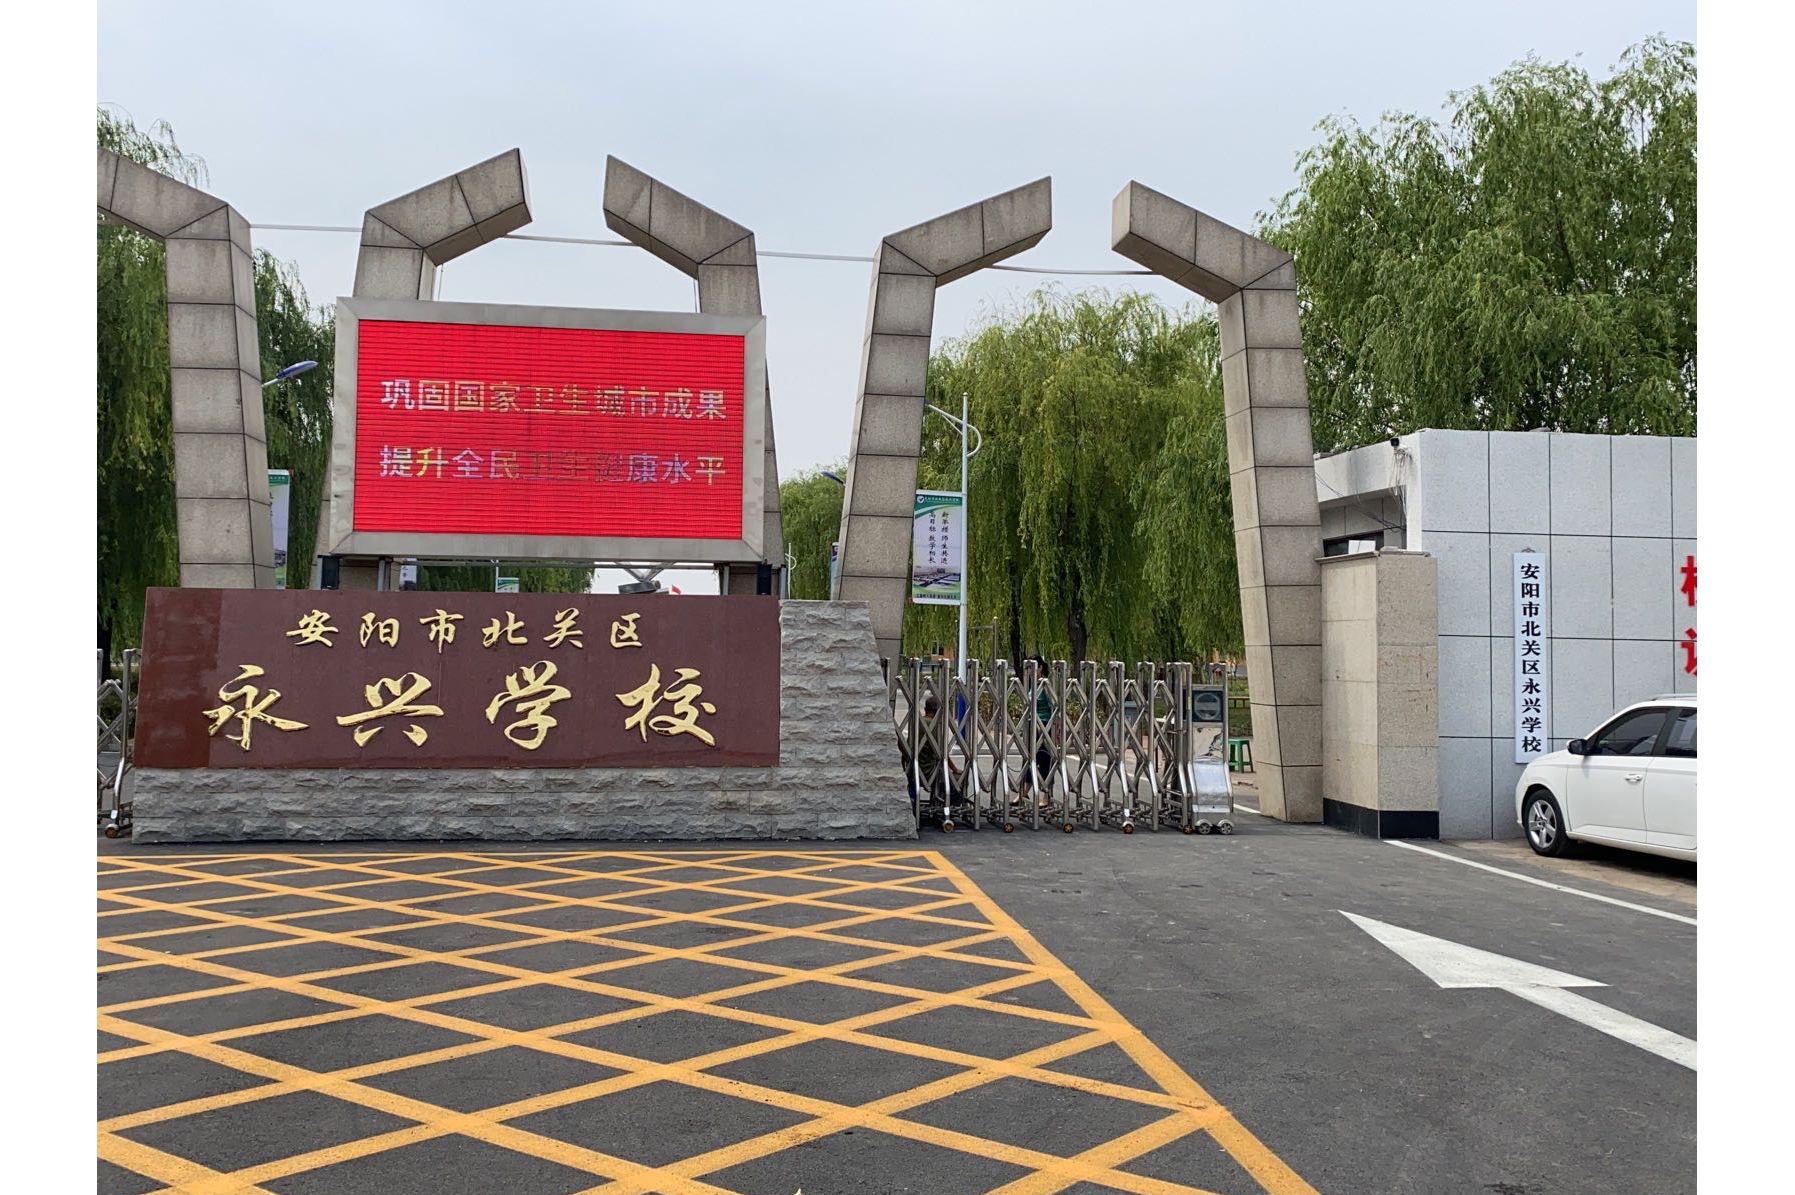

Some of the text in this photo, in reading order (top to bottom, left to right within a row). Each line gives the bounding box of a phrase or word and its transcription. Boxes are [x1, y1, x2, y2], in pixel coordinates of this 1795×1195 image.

[380, 378, 727, 420] 巩固国家卫生城市成果
[379, 444, 727, 486] 提升全民卫生健康水平
[285, 608, 643, 655] 安阳市北关区
[1520, 563, 1542, 753] 安阳市北关区永兴学校
[202, 660, 717, 751] 永兴学校
